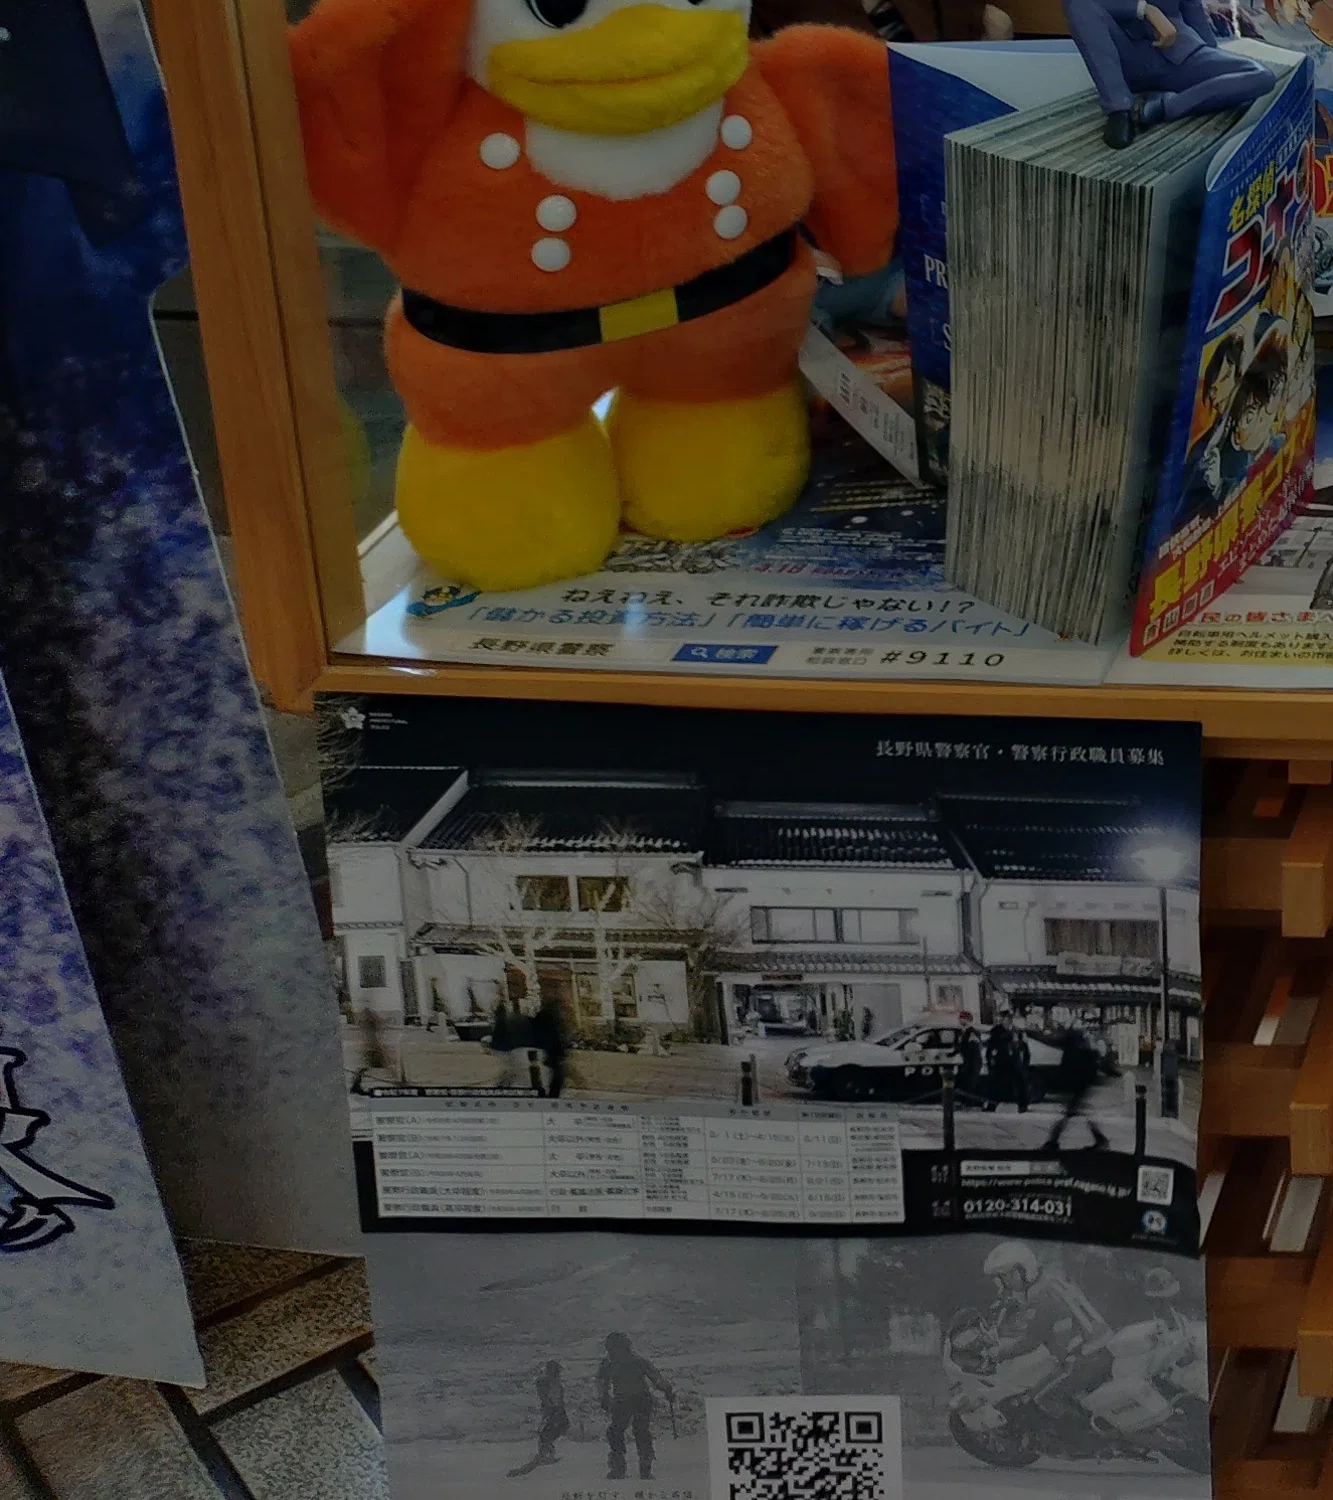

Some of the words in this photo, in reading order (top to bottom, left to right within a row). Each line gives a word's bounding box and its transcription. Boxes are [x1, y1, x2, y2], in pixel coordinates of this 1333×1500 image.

[470, 637, 613, 658] 長野県警察
[879, 648, 1007, 668] #9110
[963, 1195, 1073, 1217] 0120-314-031
